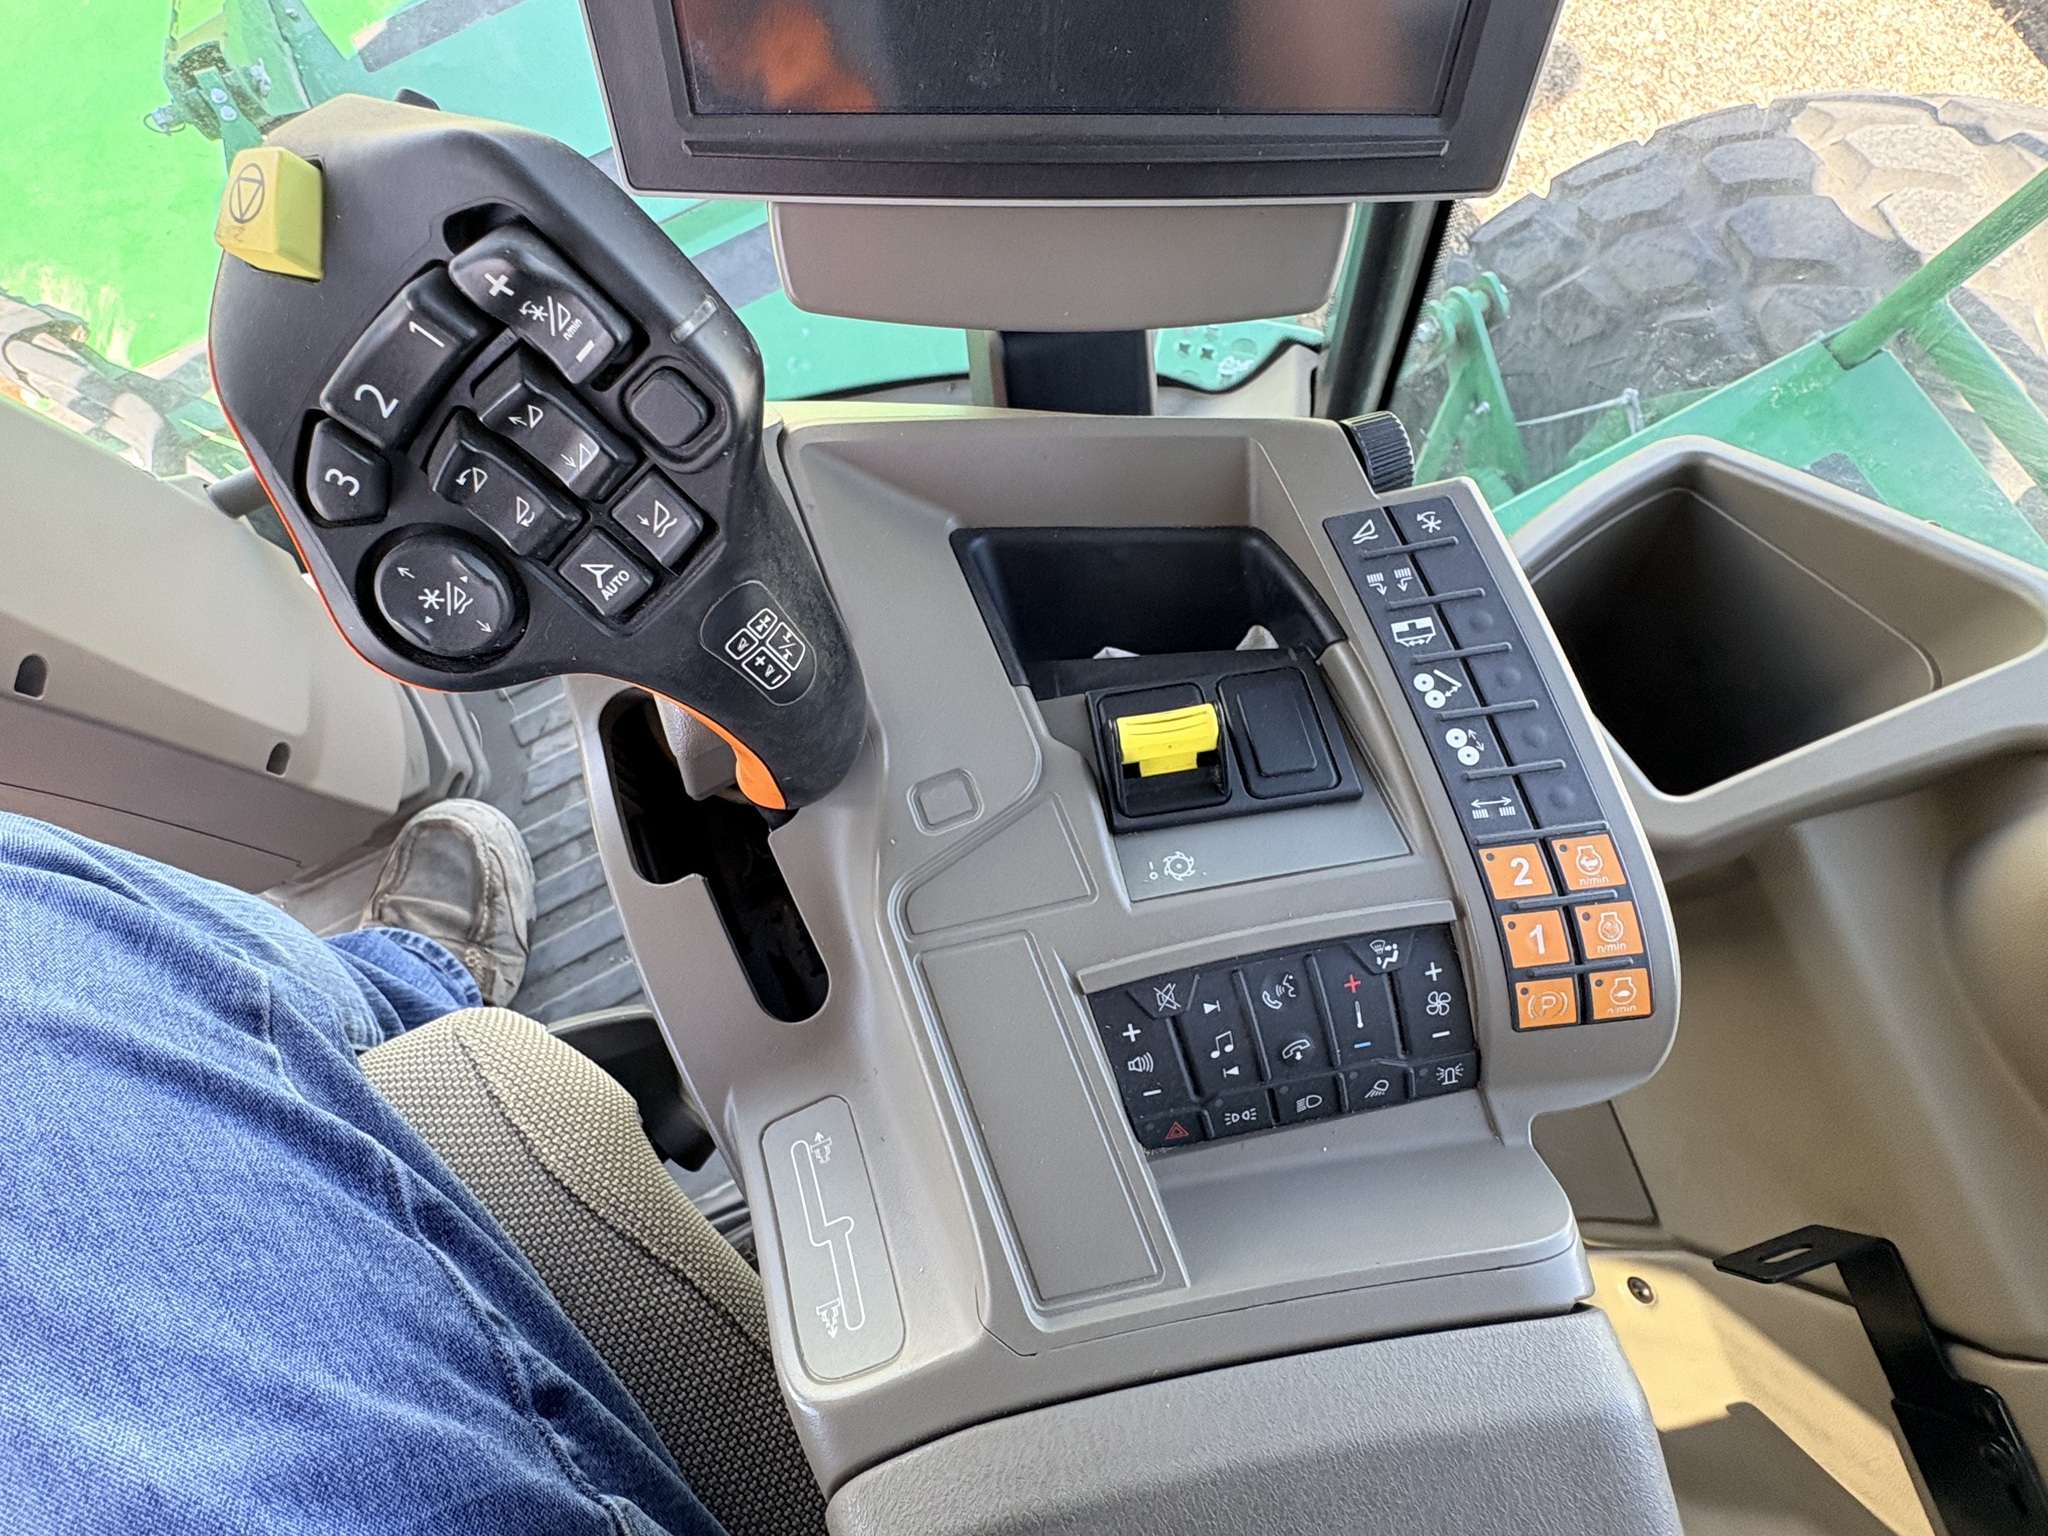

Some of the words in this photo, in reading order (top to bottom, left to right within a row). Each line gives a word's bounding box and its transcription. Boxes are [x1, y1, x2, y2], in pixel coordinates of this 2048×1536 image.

[408, 321, 445, 349] 1
[354, 384, 399, 419] 2
[325, 468, 360, 497] 3
[601, 570, 630, 601] AUTO
[1510, 857, 1534, 887] 2
[1579, 874, 1610, 886] n/min
[1529, 924, 1546, 955] 1
[1596, 941, 1627, 954] n/min
